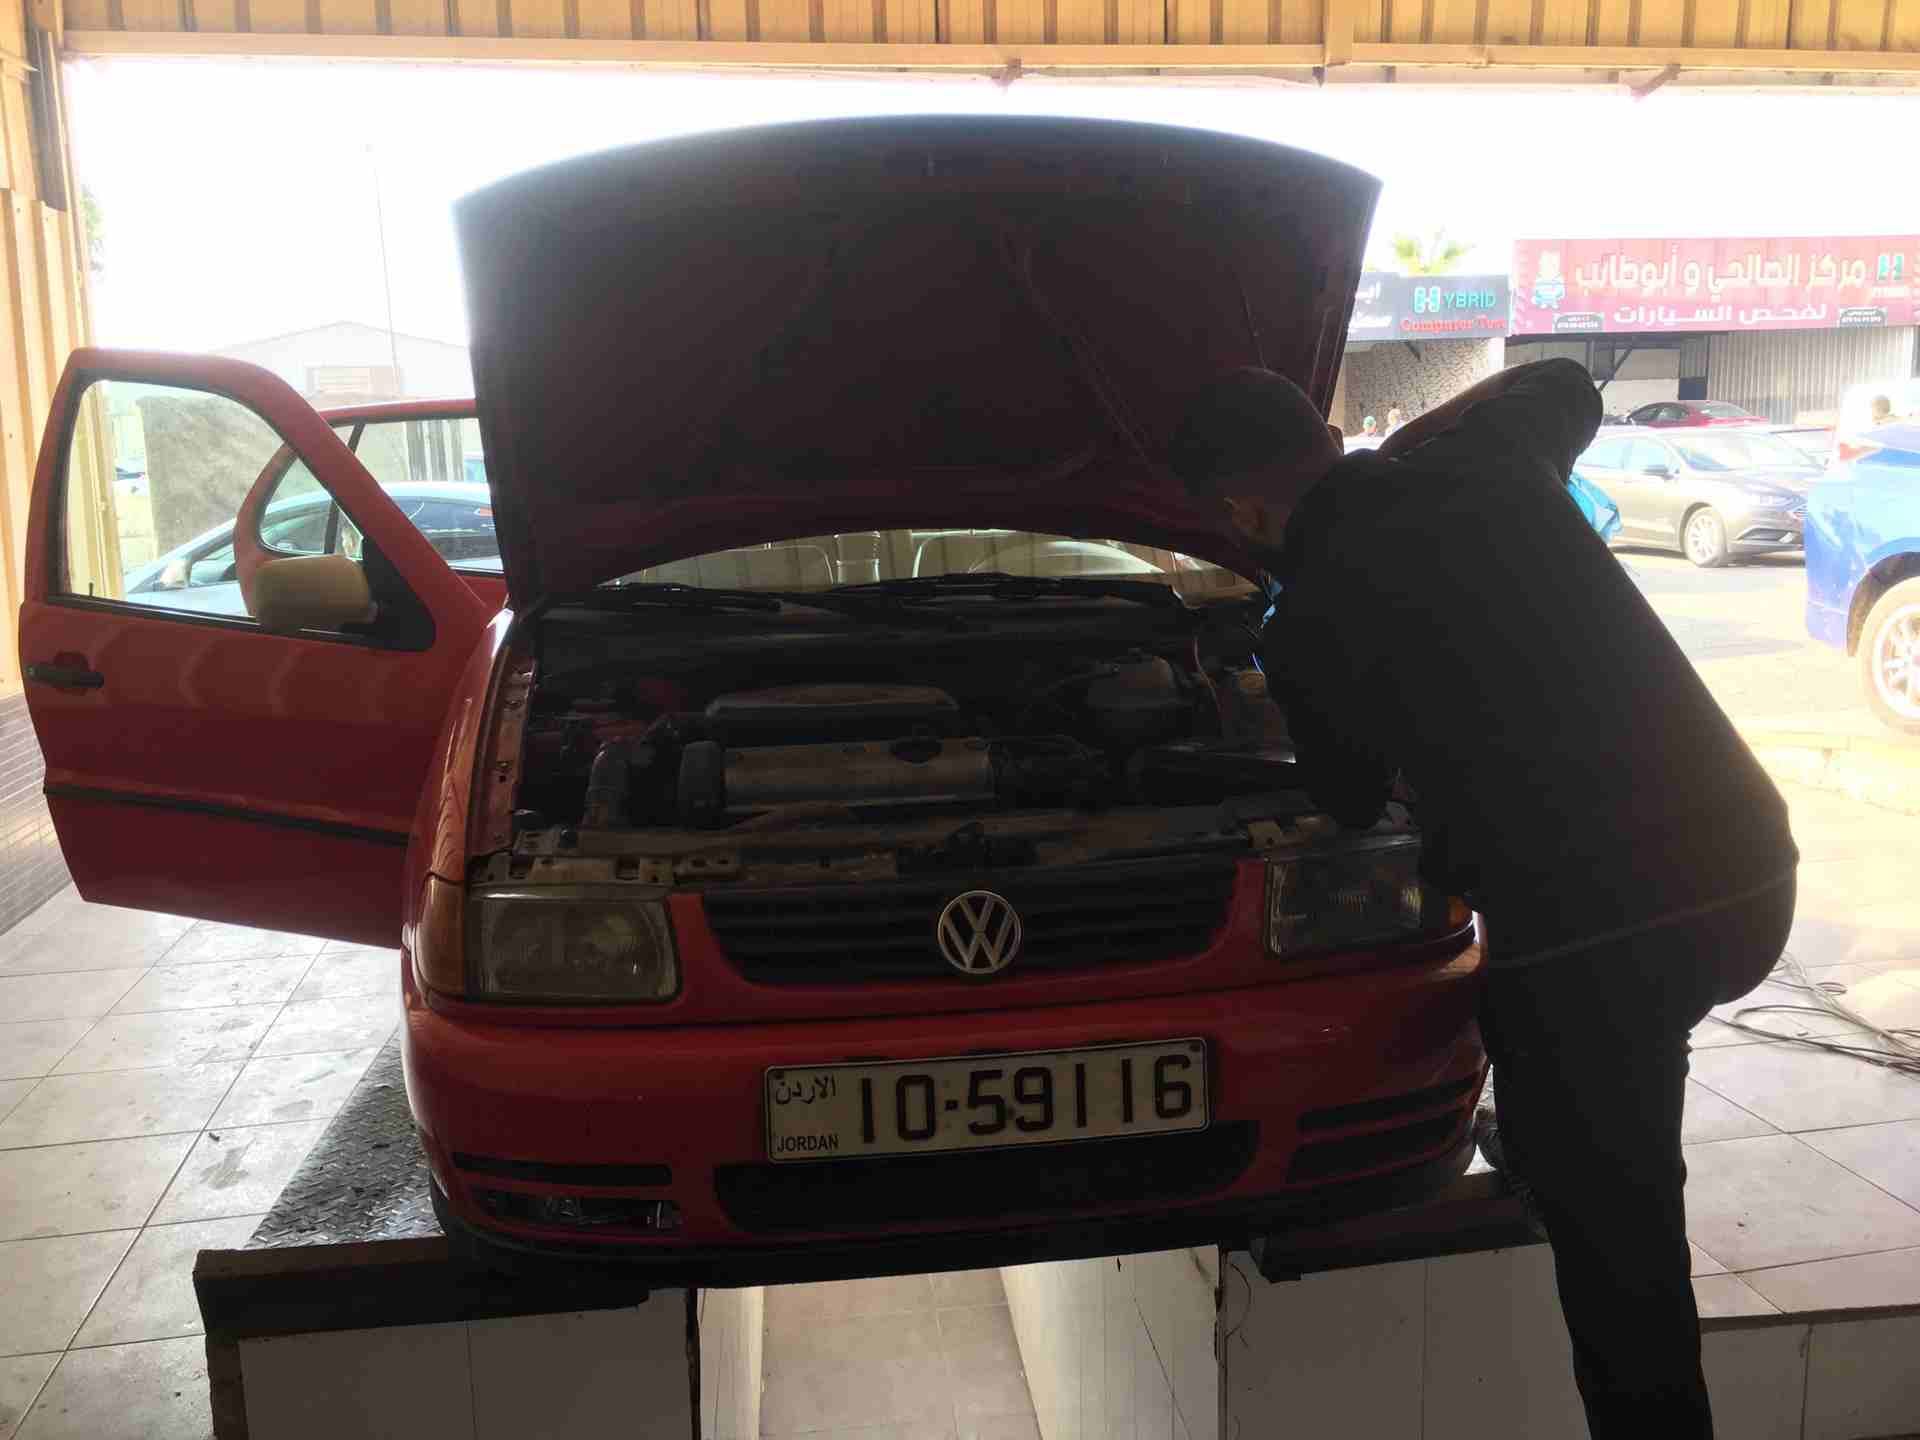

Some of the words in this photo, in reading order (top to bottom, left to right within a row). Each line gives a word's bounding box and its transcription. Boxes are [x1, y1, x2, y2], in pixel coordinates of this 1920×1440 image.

[1807, 252, 1866, 291] مركز
[1613, 304, 1732, 327] السيارات
[1738, 303, 1827, 325] لفحص
[776, 1135, 839, 1152] JORDAN
